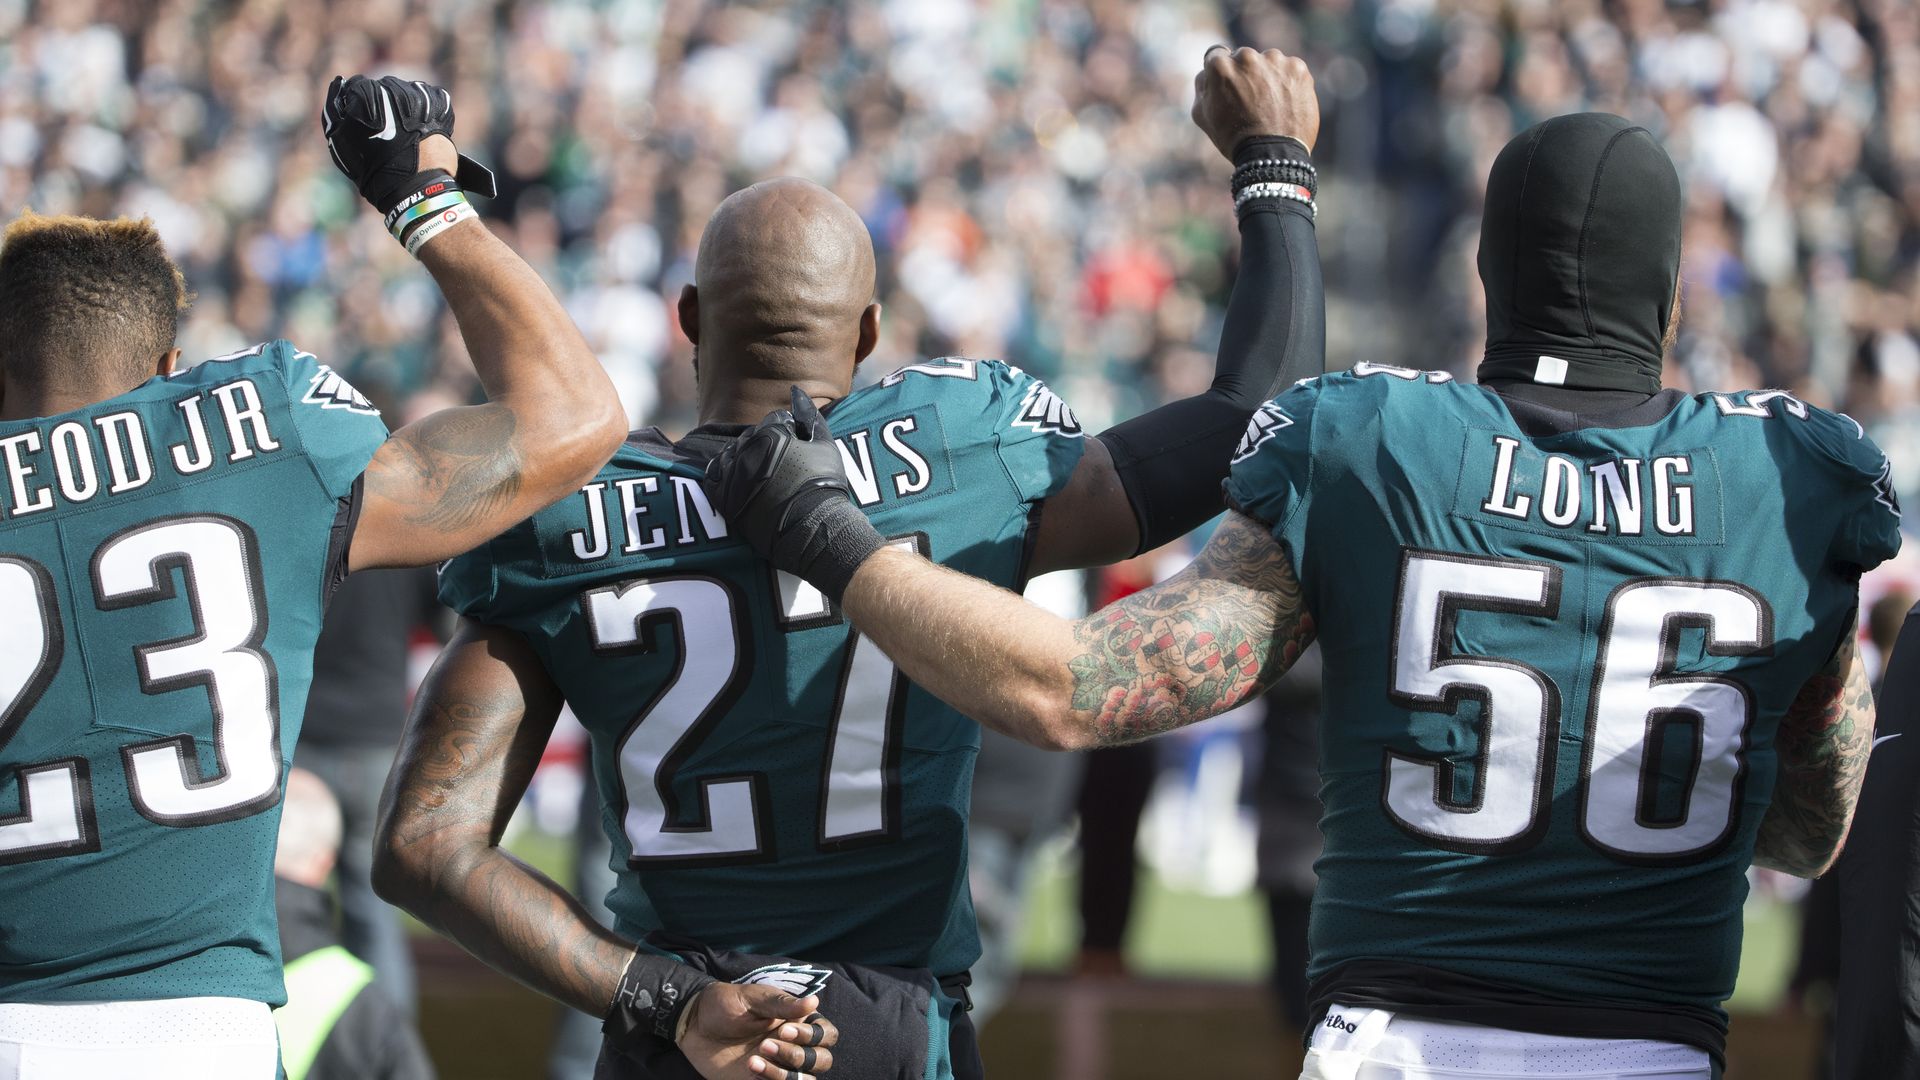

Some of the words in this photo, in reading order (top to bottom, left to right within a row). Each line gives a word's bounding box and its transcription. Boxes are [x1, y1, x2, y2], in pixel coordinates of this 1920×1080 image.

[419, 219, 442, 237] Option
[0, 408, 156, 520] EOD
[169, 377, 284, 476] JR
[564, 413, 934, 563] JENNS
[1479, 433, 1698, 538] LONG
[579, 531, 932, 871] 27
[1379, 545, 1776, 868] 56
